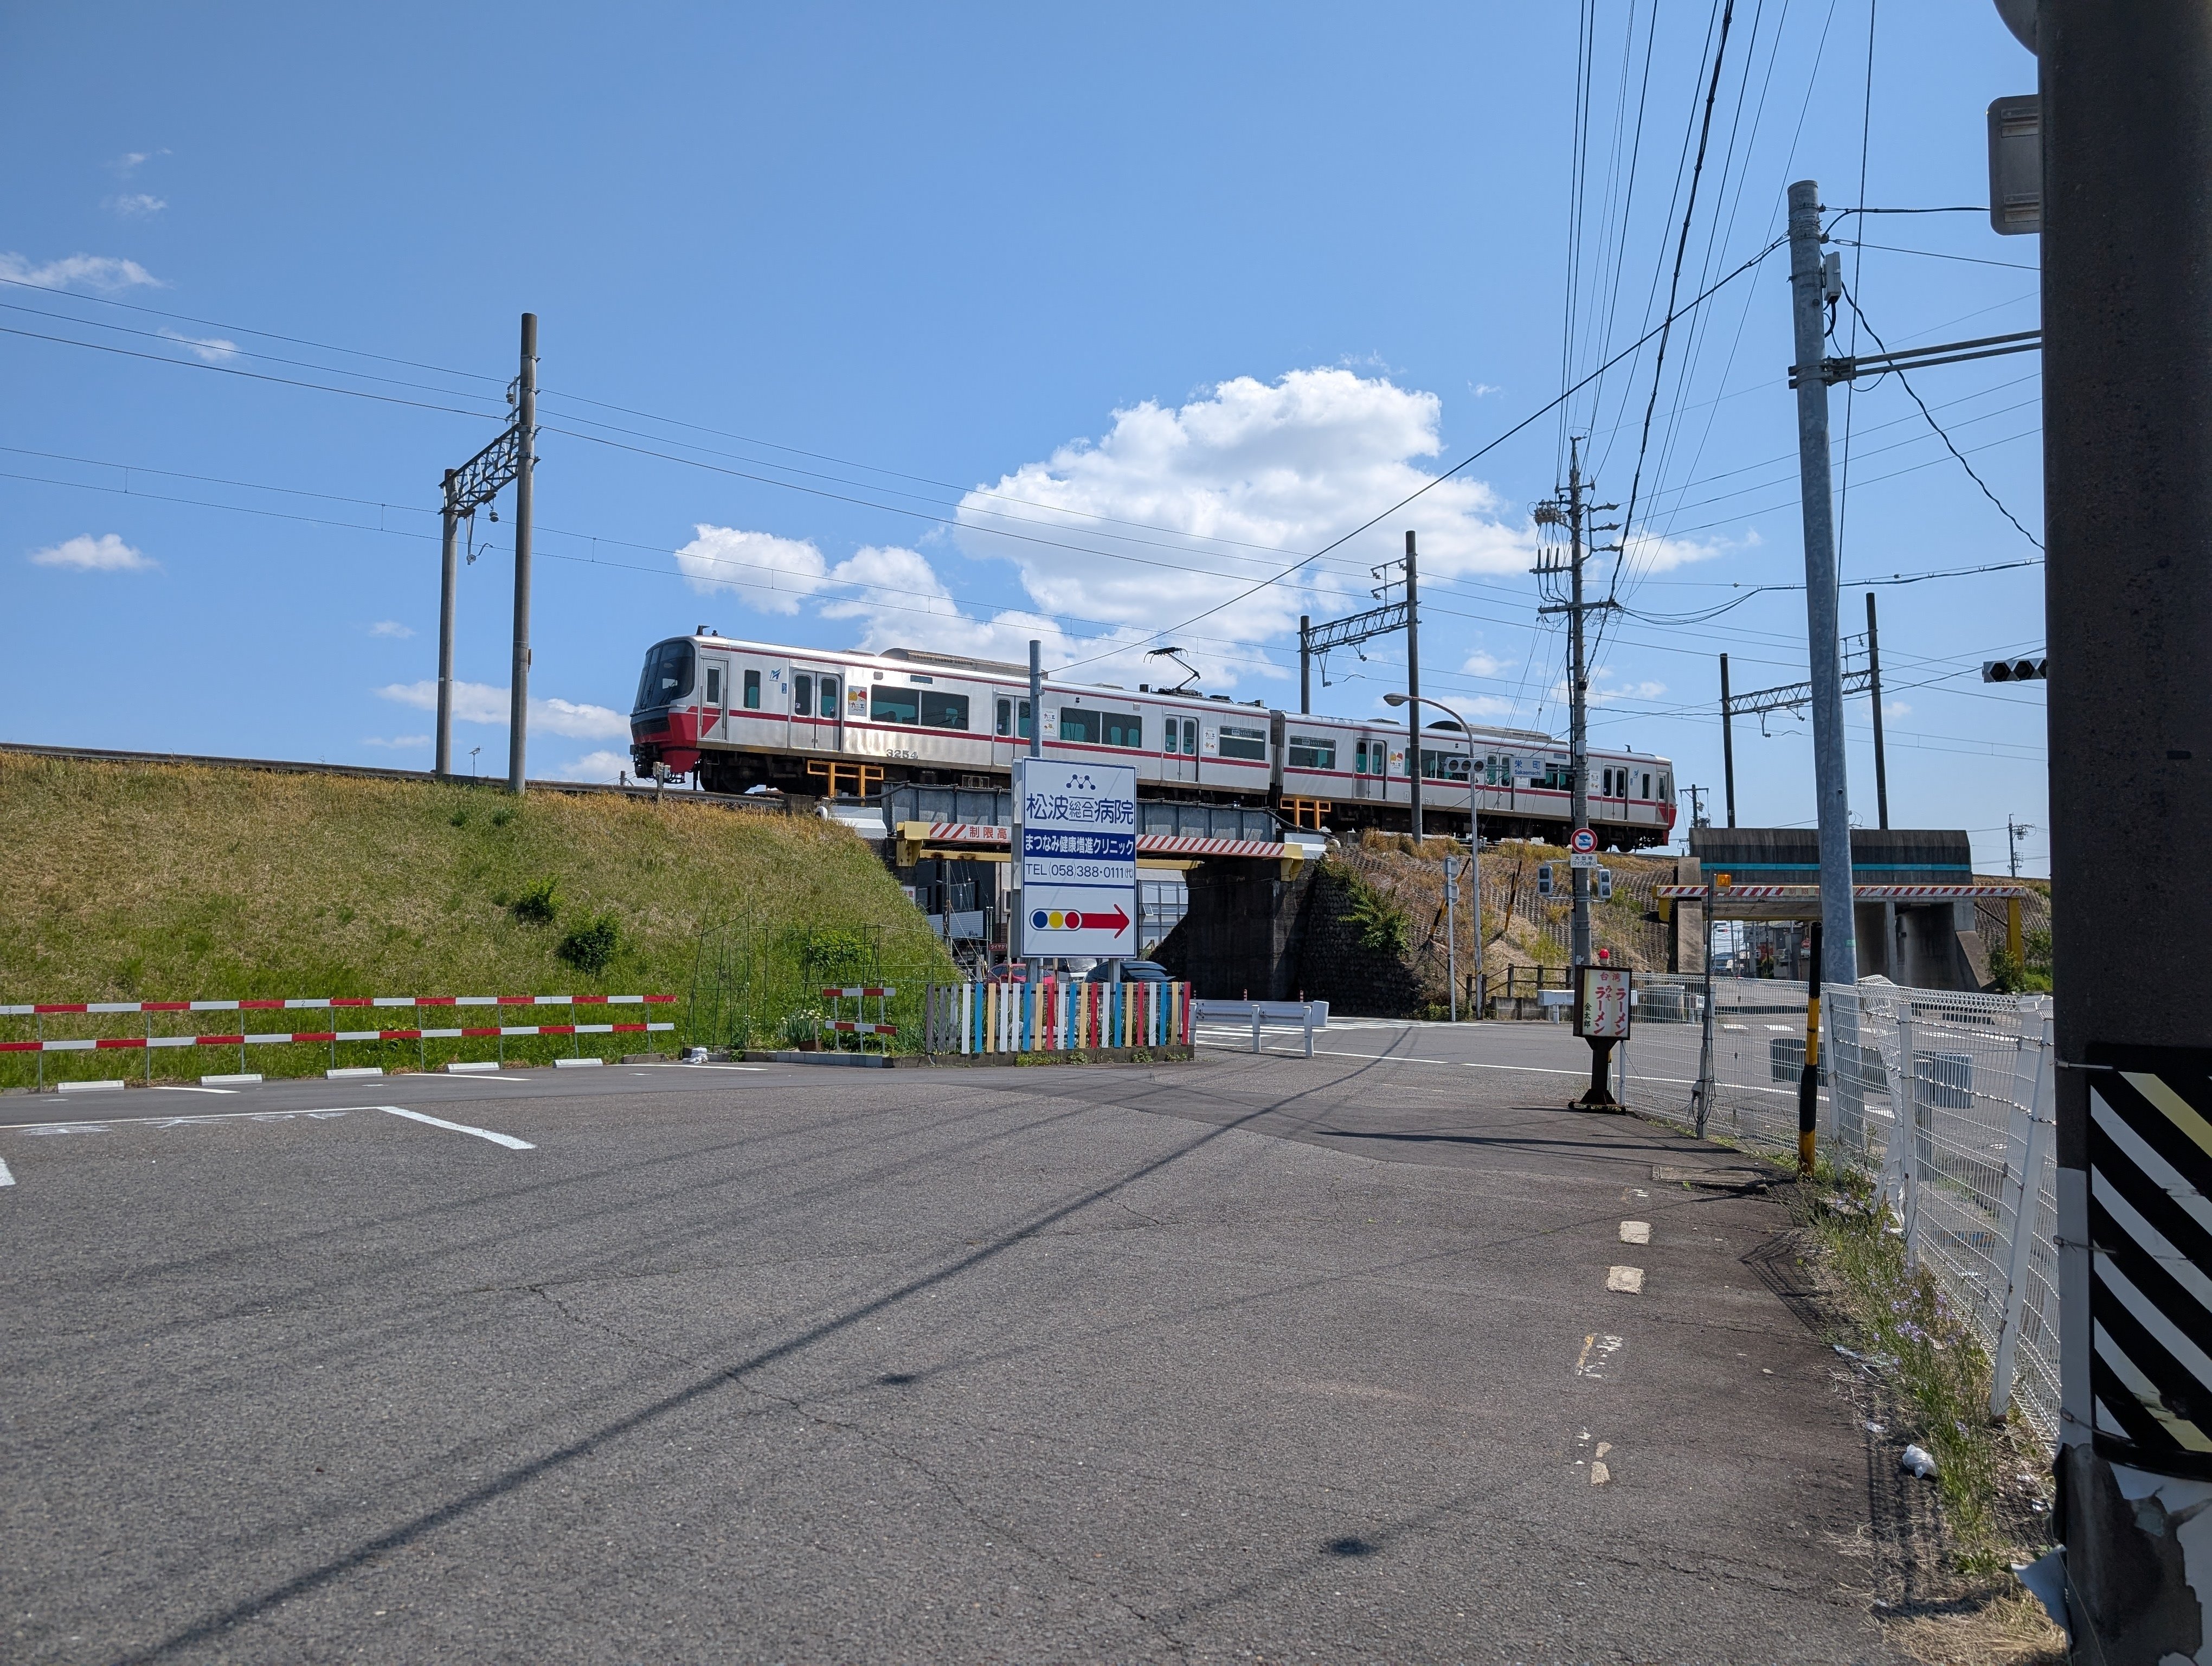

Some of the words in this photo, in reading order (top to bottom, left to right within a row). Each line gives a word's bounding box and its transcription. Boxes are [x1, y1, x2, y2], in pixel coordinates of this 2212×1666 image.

[886, 749, 918, 760] 3254
[1514, 760, 1540, 769] 栄町
[1026, 793, 1134, 825] 松波総合病院
[969, 825, 1007, 840] 制限高
[1025, 834, 1134, 855] まつなみ健康増進クリニック
[1600, 972, 1621, 982] 台湾
[1593, 987, 1605, 1034] ラーメン
[1615, 988, 1626, 1036] ラーメン
